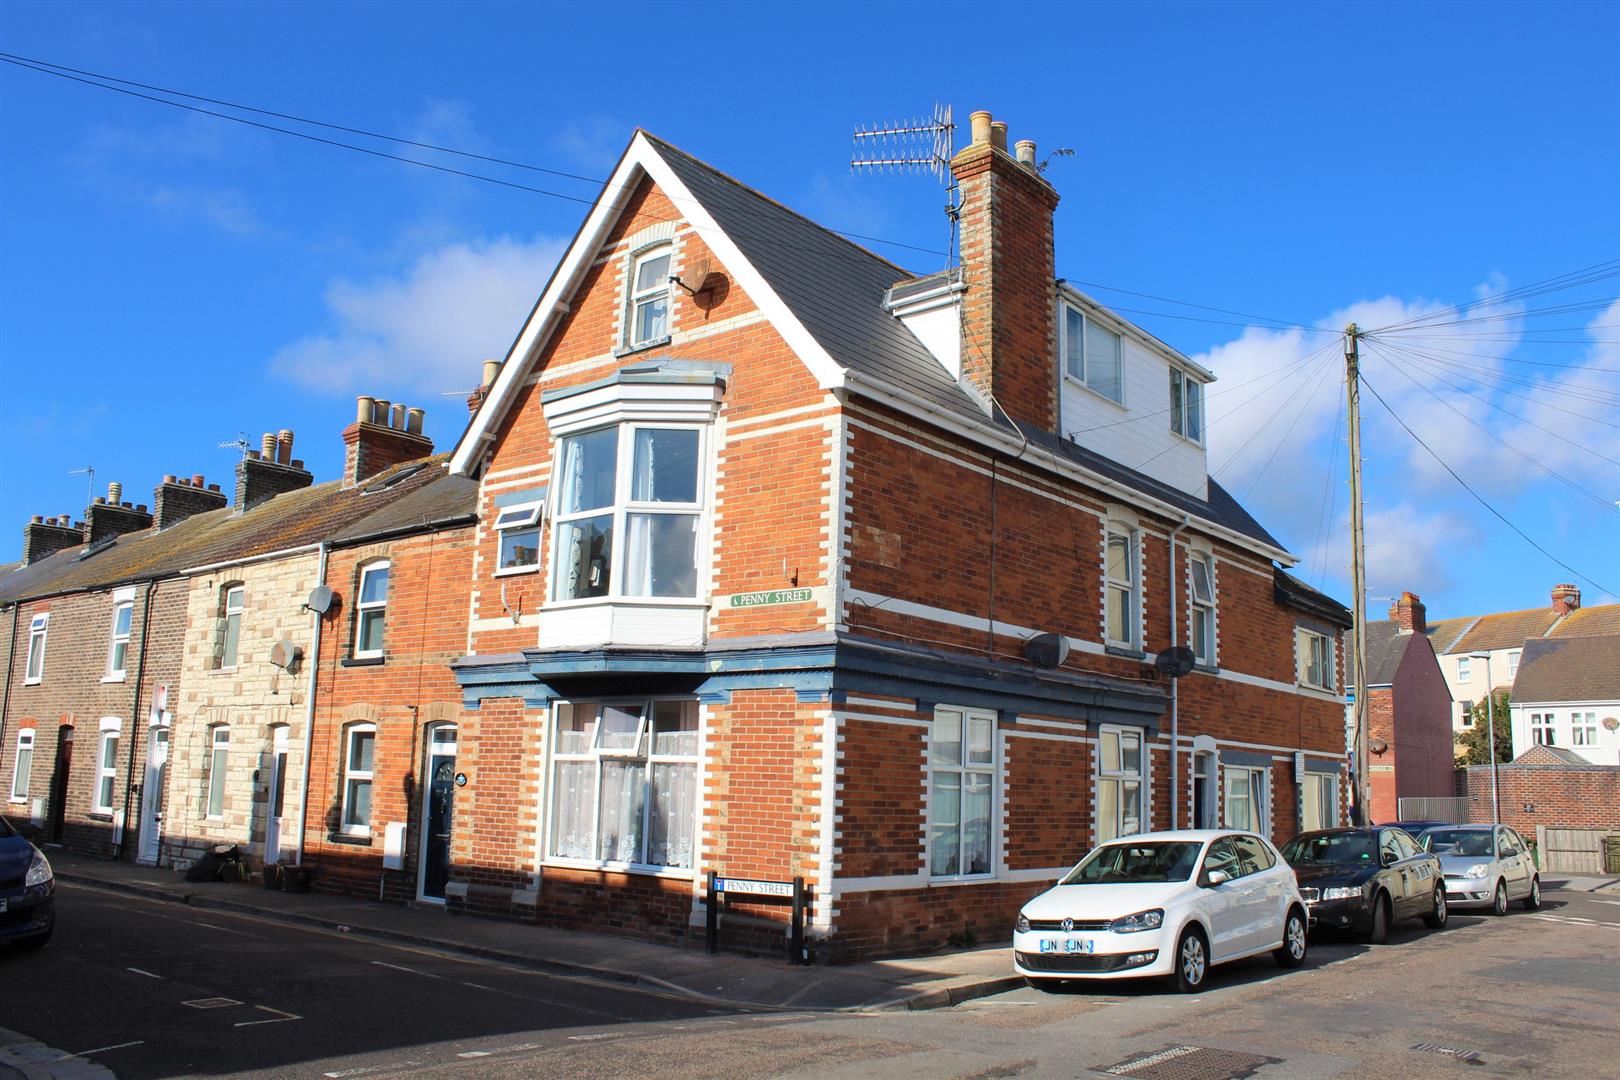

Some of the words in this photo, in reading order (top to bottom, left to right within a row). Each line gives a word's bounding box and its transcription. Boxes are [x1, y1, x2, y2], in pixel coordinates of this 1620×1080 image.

[740, 594, 769, 605] PENNY
[775, 591, 809, 602] STREET
[727, 881, 755, 892] PENNY
[759, 884, 790, 895] STREET
